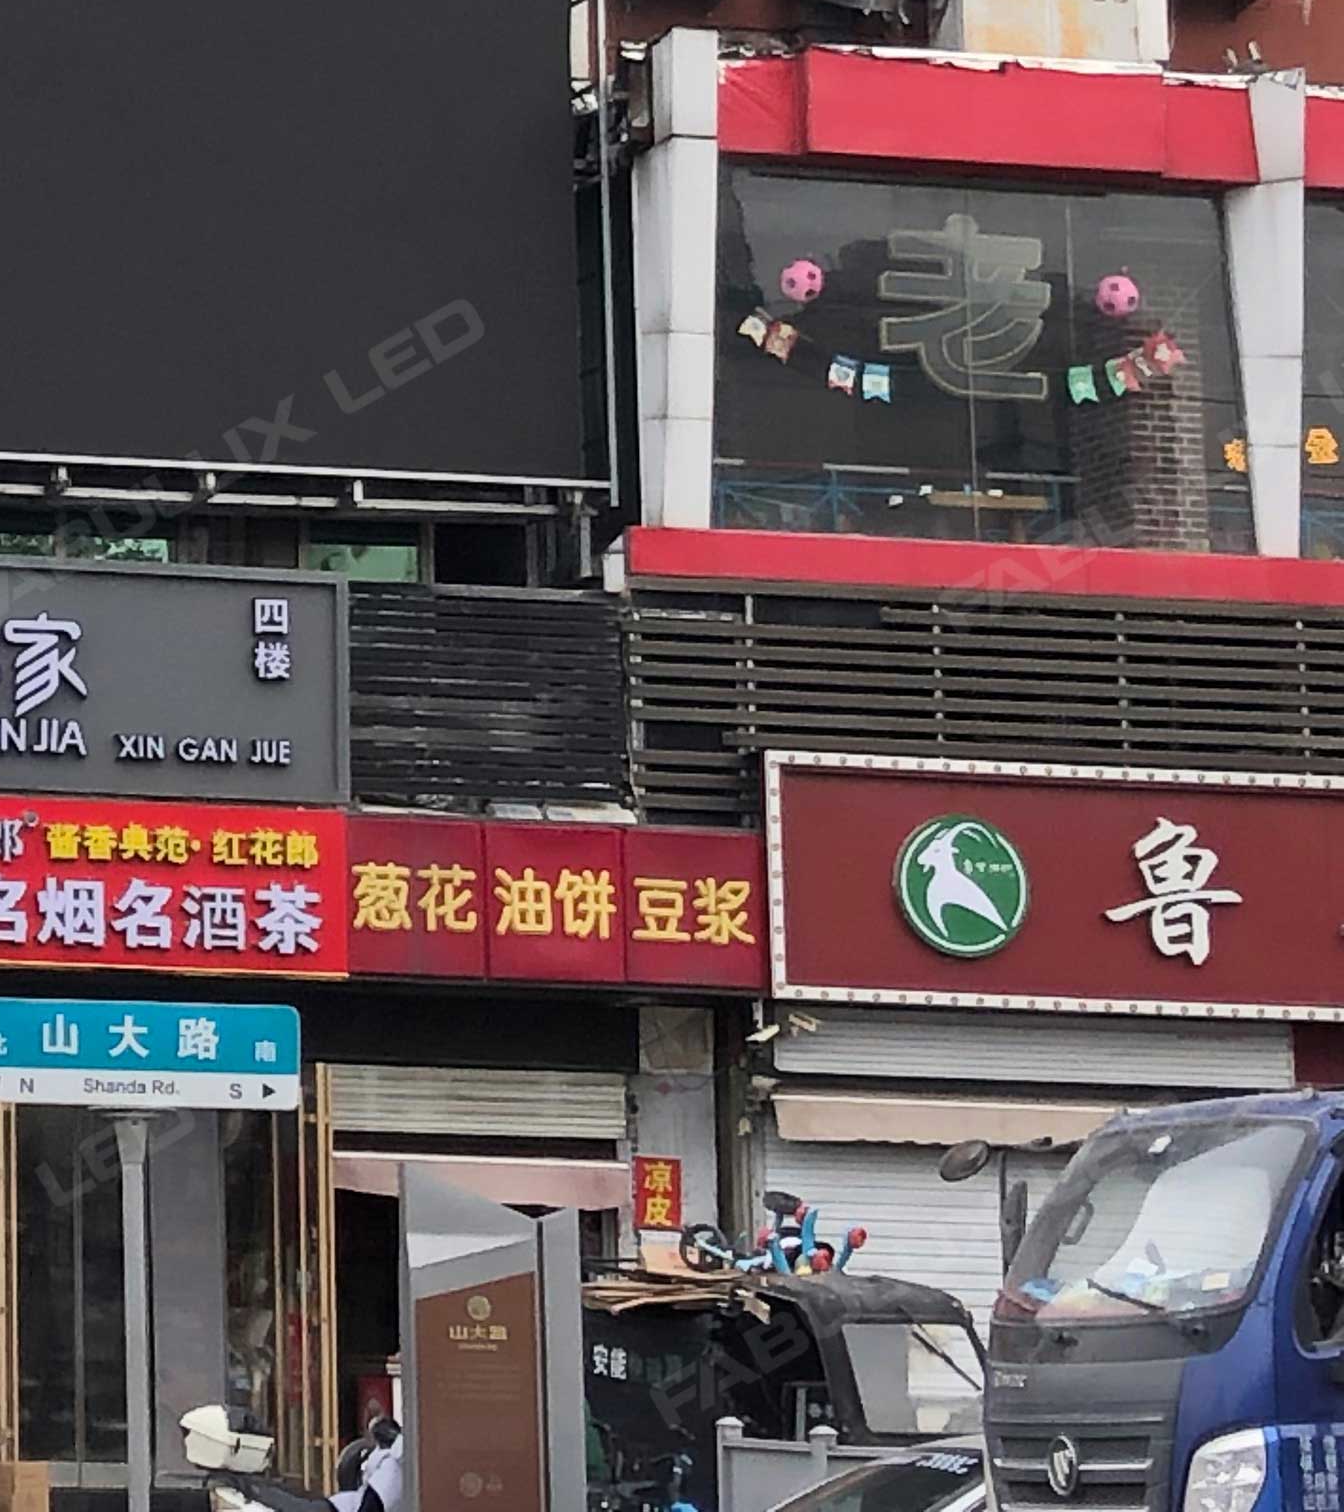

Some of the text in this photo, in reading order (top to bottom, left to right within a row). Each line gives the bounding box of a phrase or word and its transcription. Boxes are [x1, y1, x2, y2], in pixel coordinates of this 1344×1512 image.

[878, 213, 1052, 401] 老
[254, 598, 291, 679] 四楼
[118, 734, 165, 760] XIN
[178, 737, 238, 763] GAN
[250, 740, 291, 765] JUE
[351, 862, 756, 945] 葱花 油饼 豆浆
[1104, 816, 1244, 967] 鲁
[42, 1013, 220, 1061] 山大路
[254, 1040, 277, 1063] 南
[19, 1077, 242, 1099] N Shanda Rd. S
[644, 1161, 673, 1227] 凉皮
